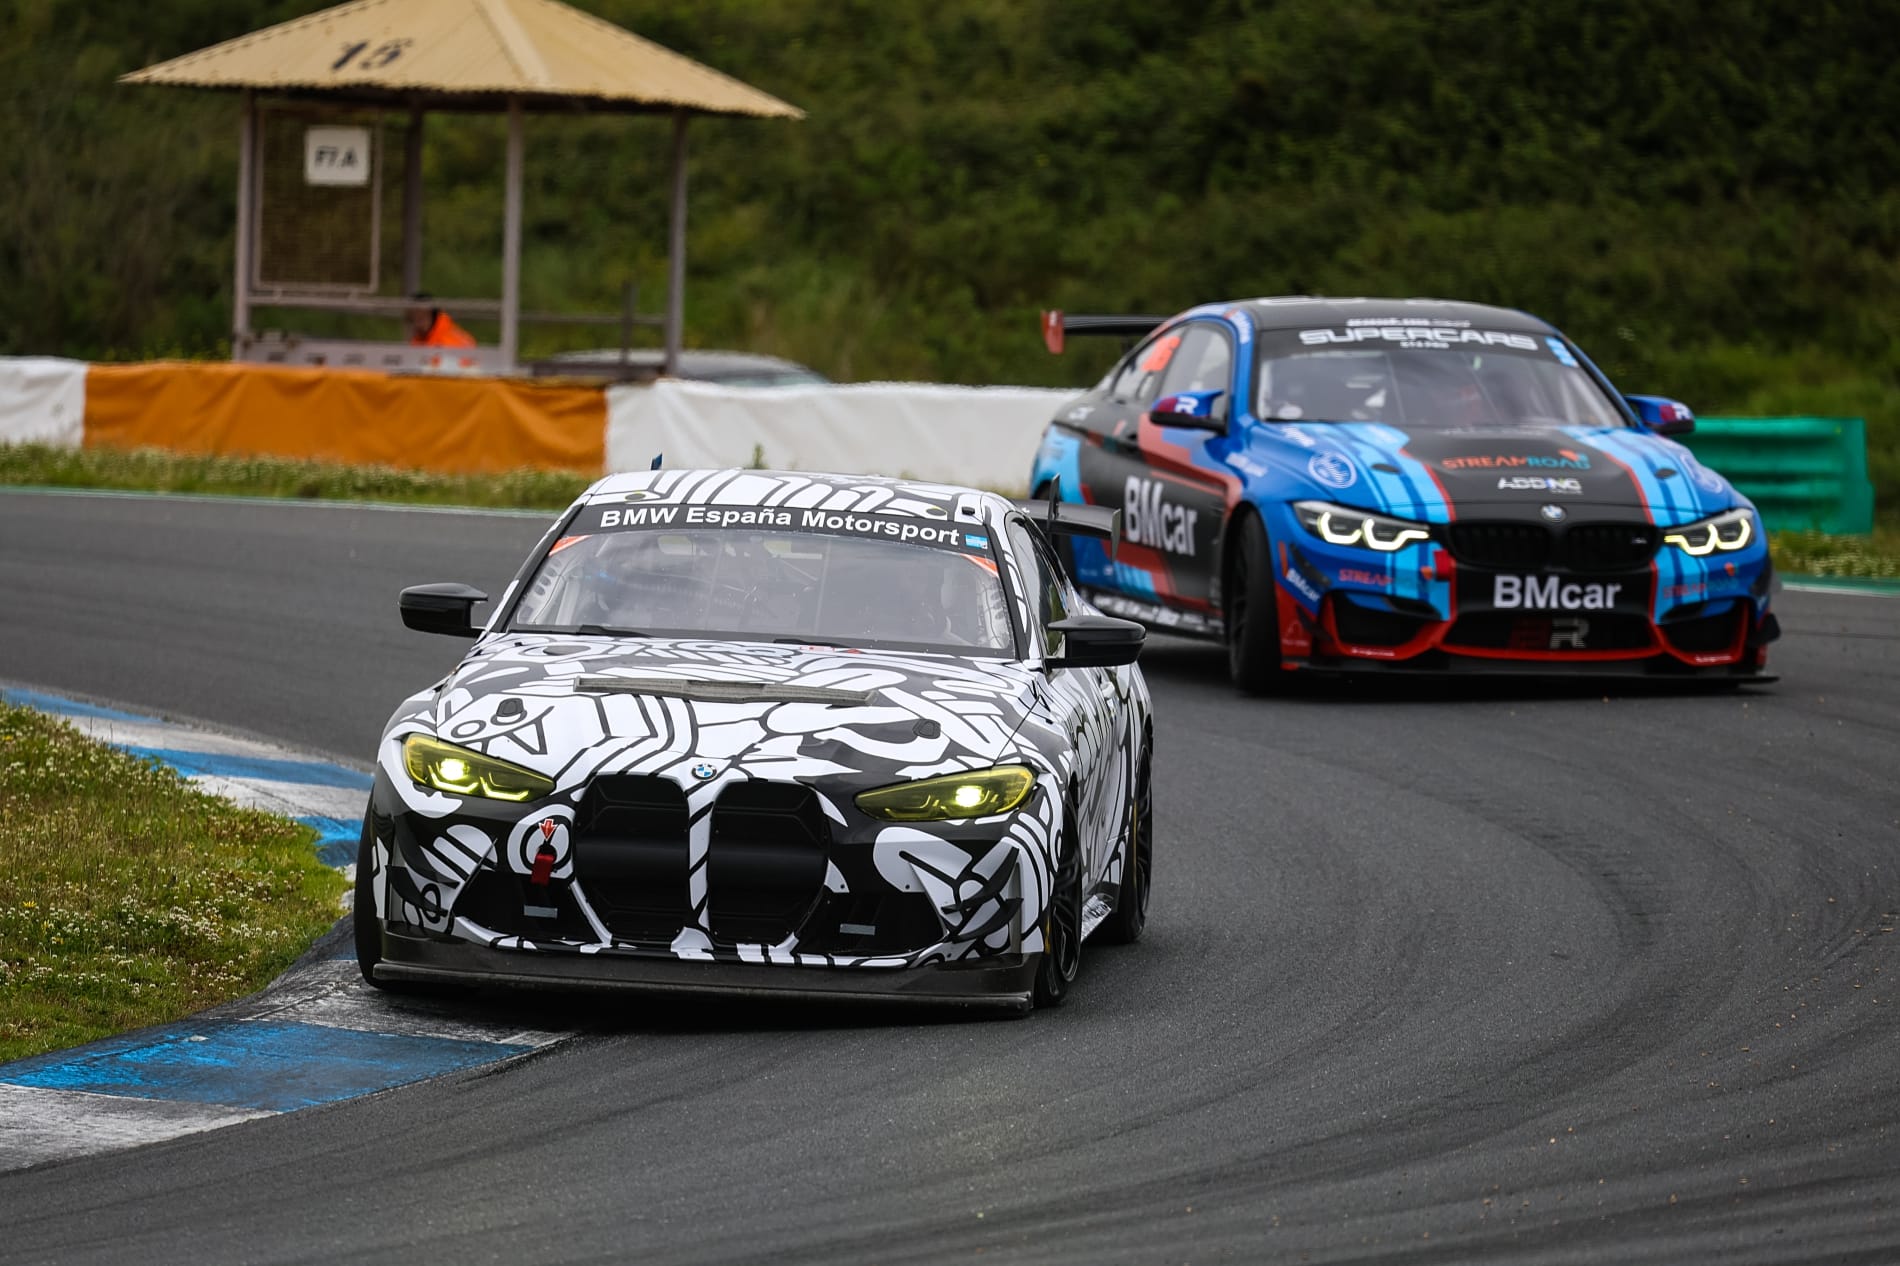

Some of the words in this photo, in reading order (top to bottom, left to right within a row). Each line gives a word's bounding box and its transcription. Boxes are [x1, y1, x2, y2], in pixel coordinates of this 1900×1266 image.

[331, 37, 412, 71] 15
[1300, 327, 1538, 350] SUPERCARS
[600, 508, 677, 528] BMW
[685, 507, 791, 527] España
[801, 512, 959, 546] Motorsport
[1125, 475, 1197, 556] BMcar
[1493, 575, 1622, 609] BMcar
